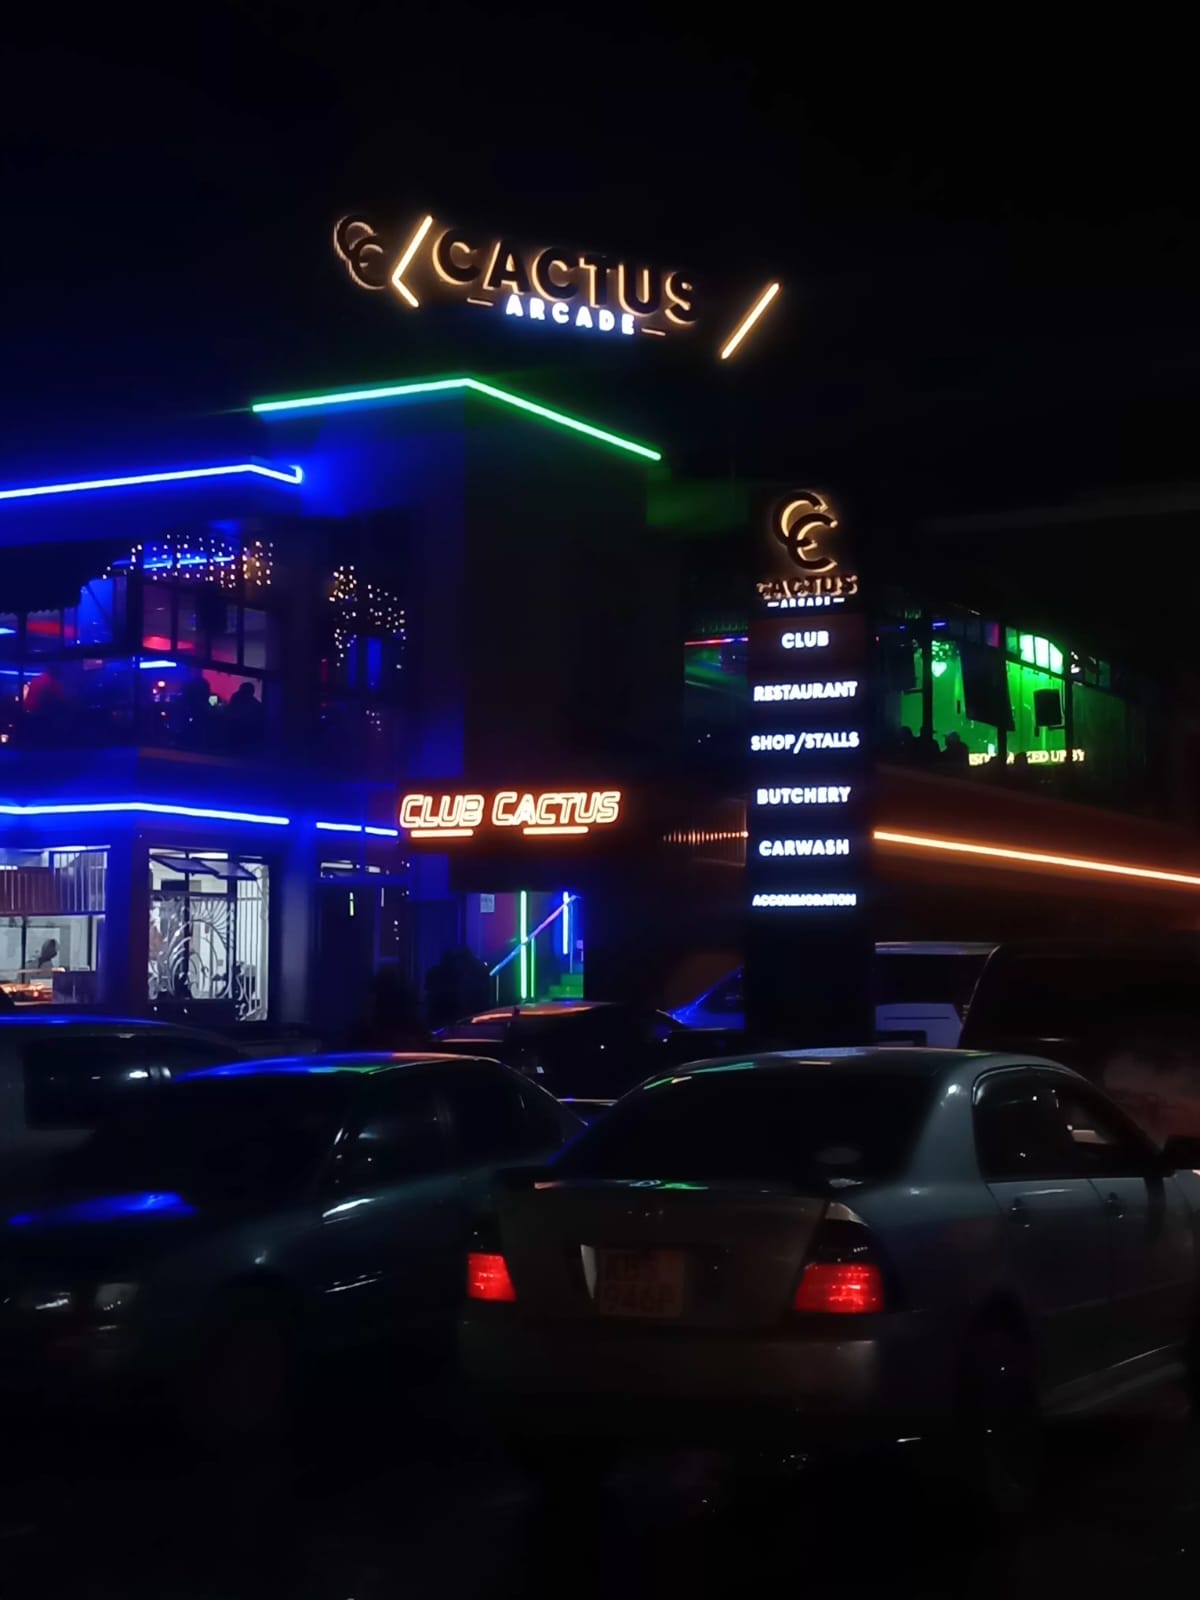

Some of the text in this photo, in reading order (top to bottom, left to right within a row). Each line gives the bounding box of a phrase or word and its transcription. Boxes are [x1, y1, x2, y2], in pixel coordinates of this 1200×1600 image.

[432, 228, 701, 325] CACTUS
[506, 294, 636, 335] ARCADE
[756, 574, 859, 600] CACTUS
[781, 630, 830, 649] CLUB
[753, 681, 858, 702] RESTAURANT
[750, 731, 860, 754] SHOP/STALLS
[756, 786, 852, 805] BUTCHERY
[399, 791, 621, 828] CLUB CACTUS
[758, 838, 850, 857] CARWASH
